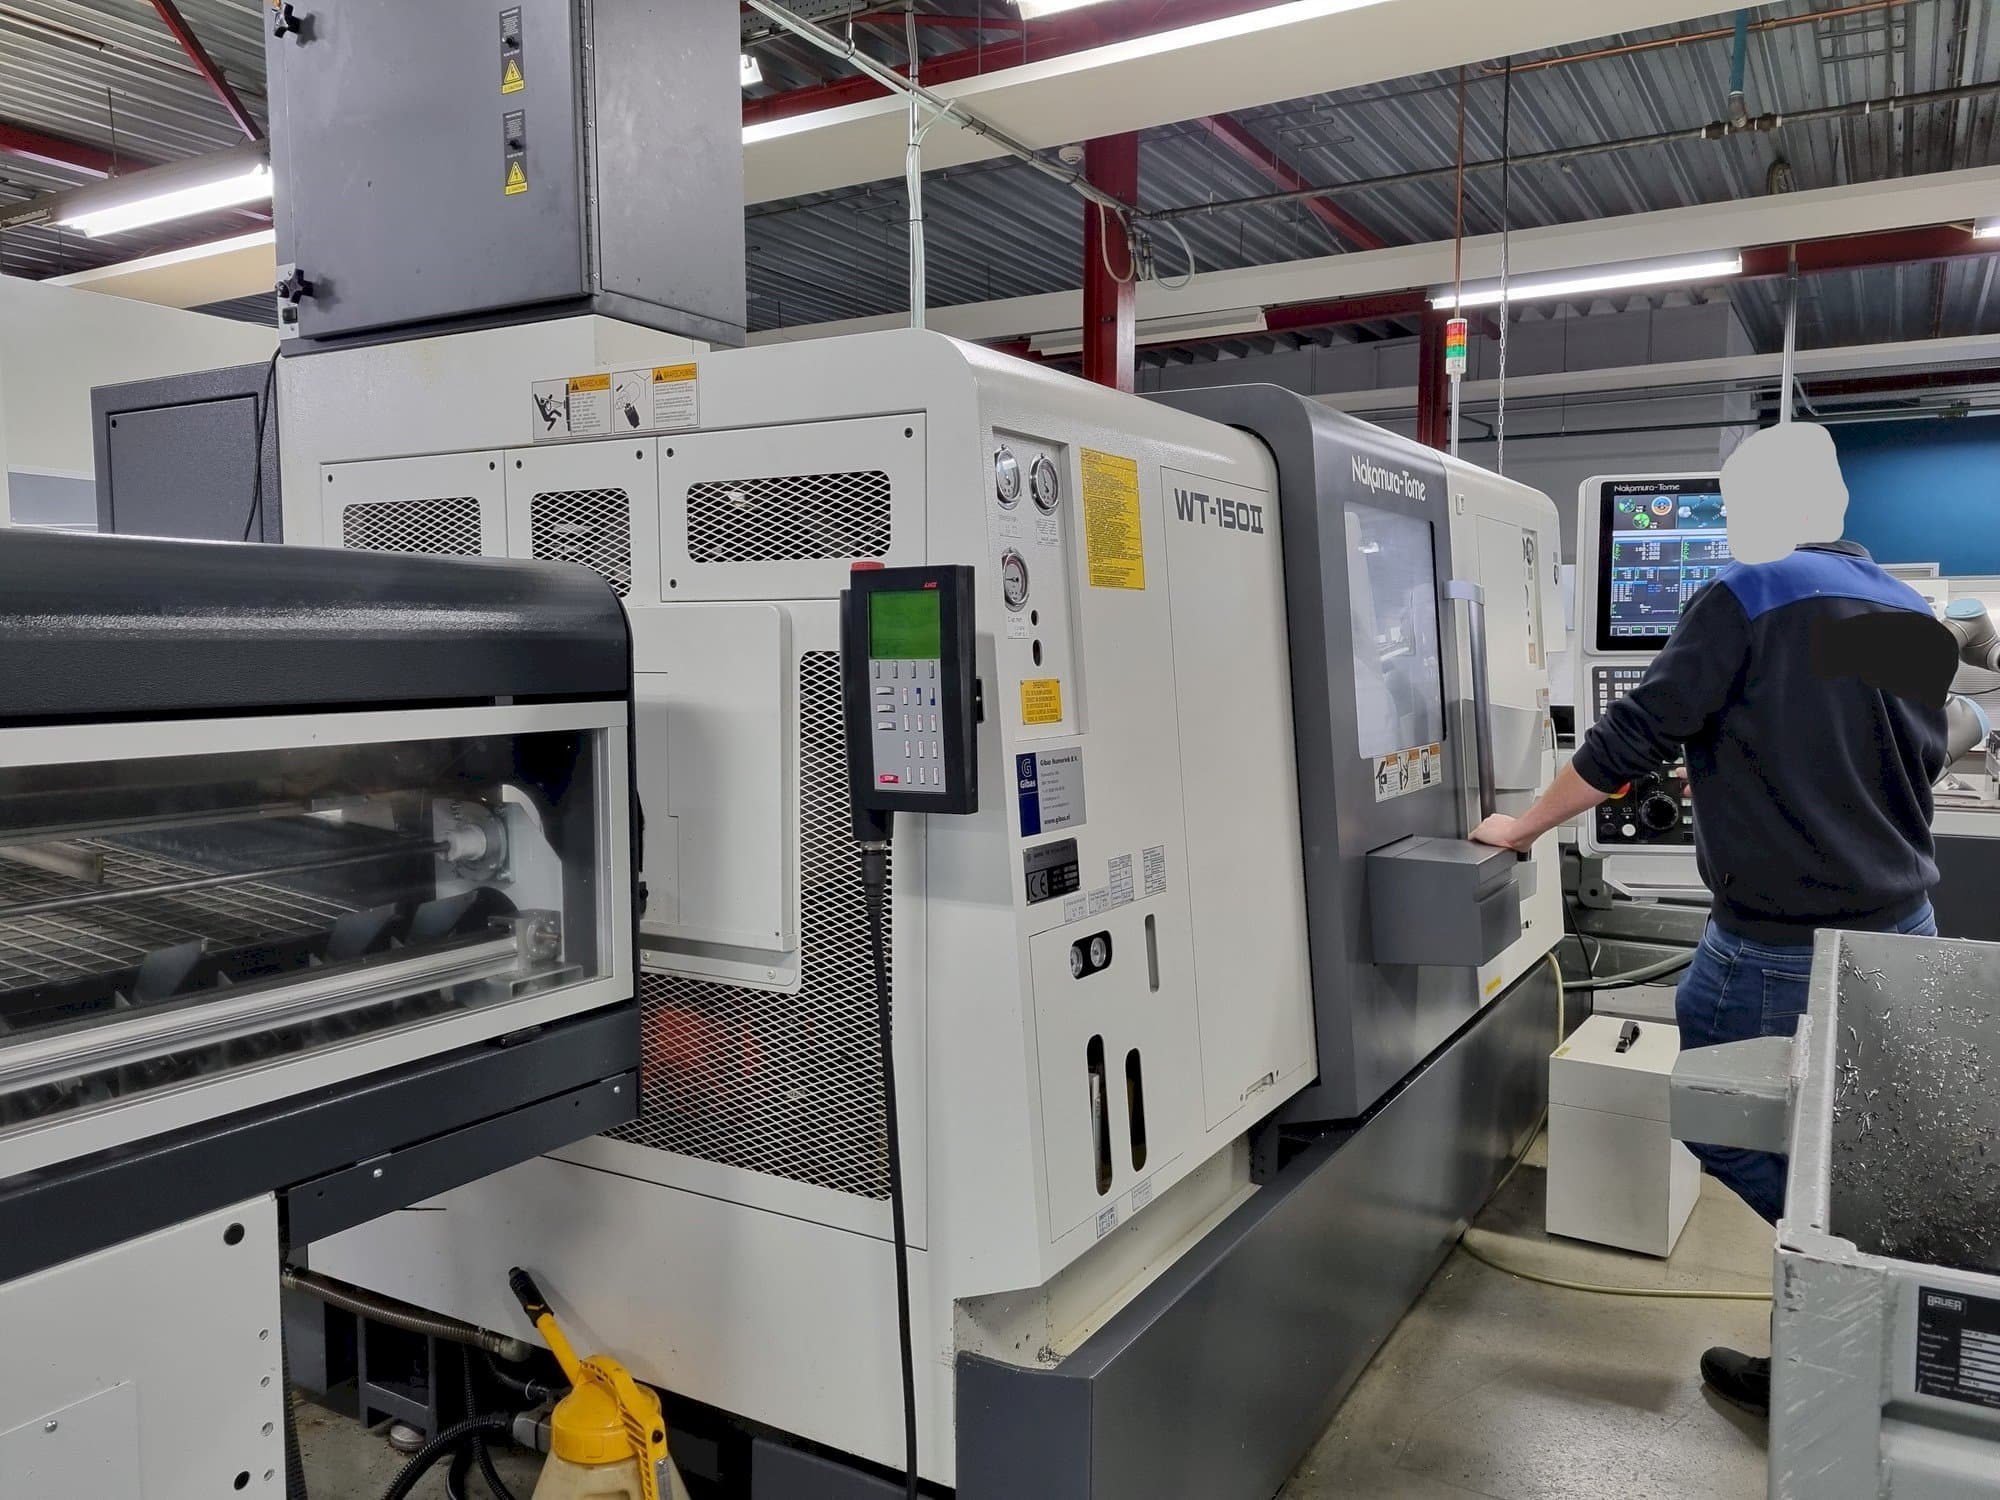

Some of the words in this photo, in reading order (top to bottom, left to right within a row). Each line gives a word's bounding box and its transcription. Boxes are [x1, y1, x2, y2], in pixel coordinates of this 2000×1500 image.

[1351, 454, 1426, 501] Nakamura-Tome
[1614, 483, 1680, 493] Nakamura-Tome
[1020, 779, 1036, 788] Gibas
[1044, 814, 1071, 825] www.gibas.nl
[1927, 1295, 1962, 1311] BAUER
